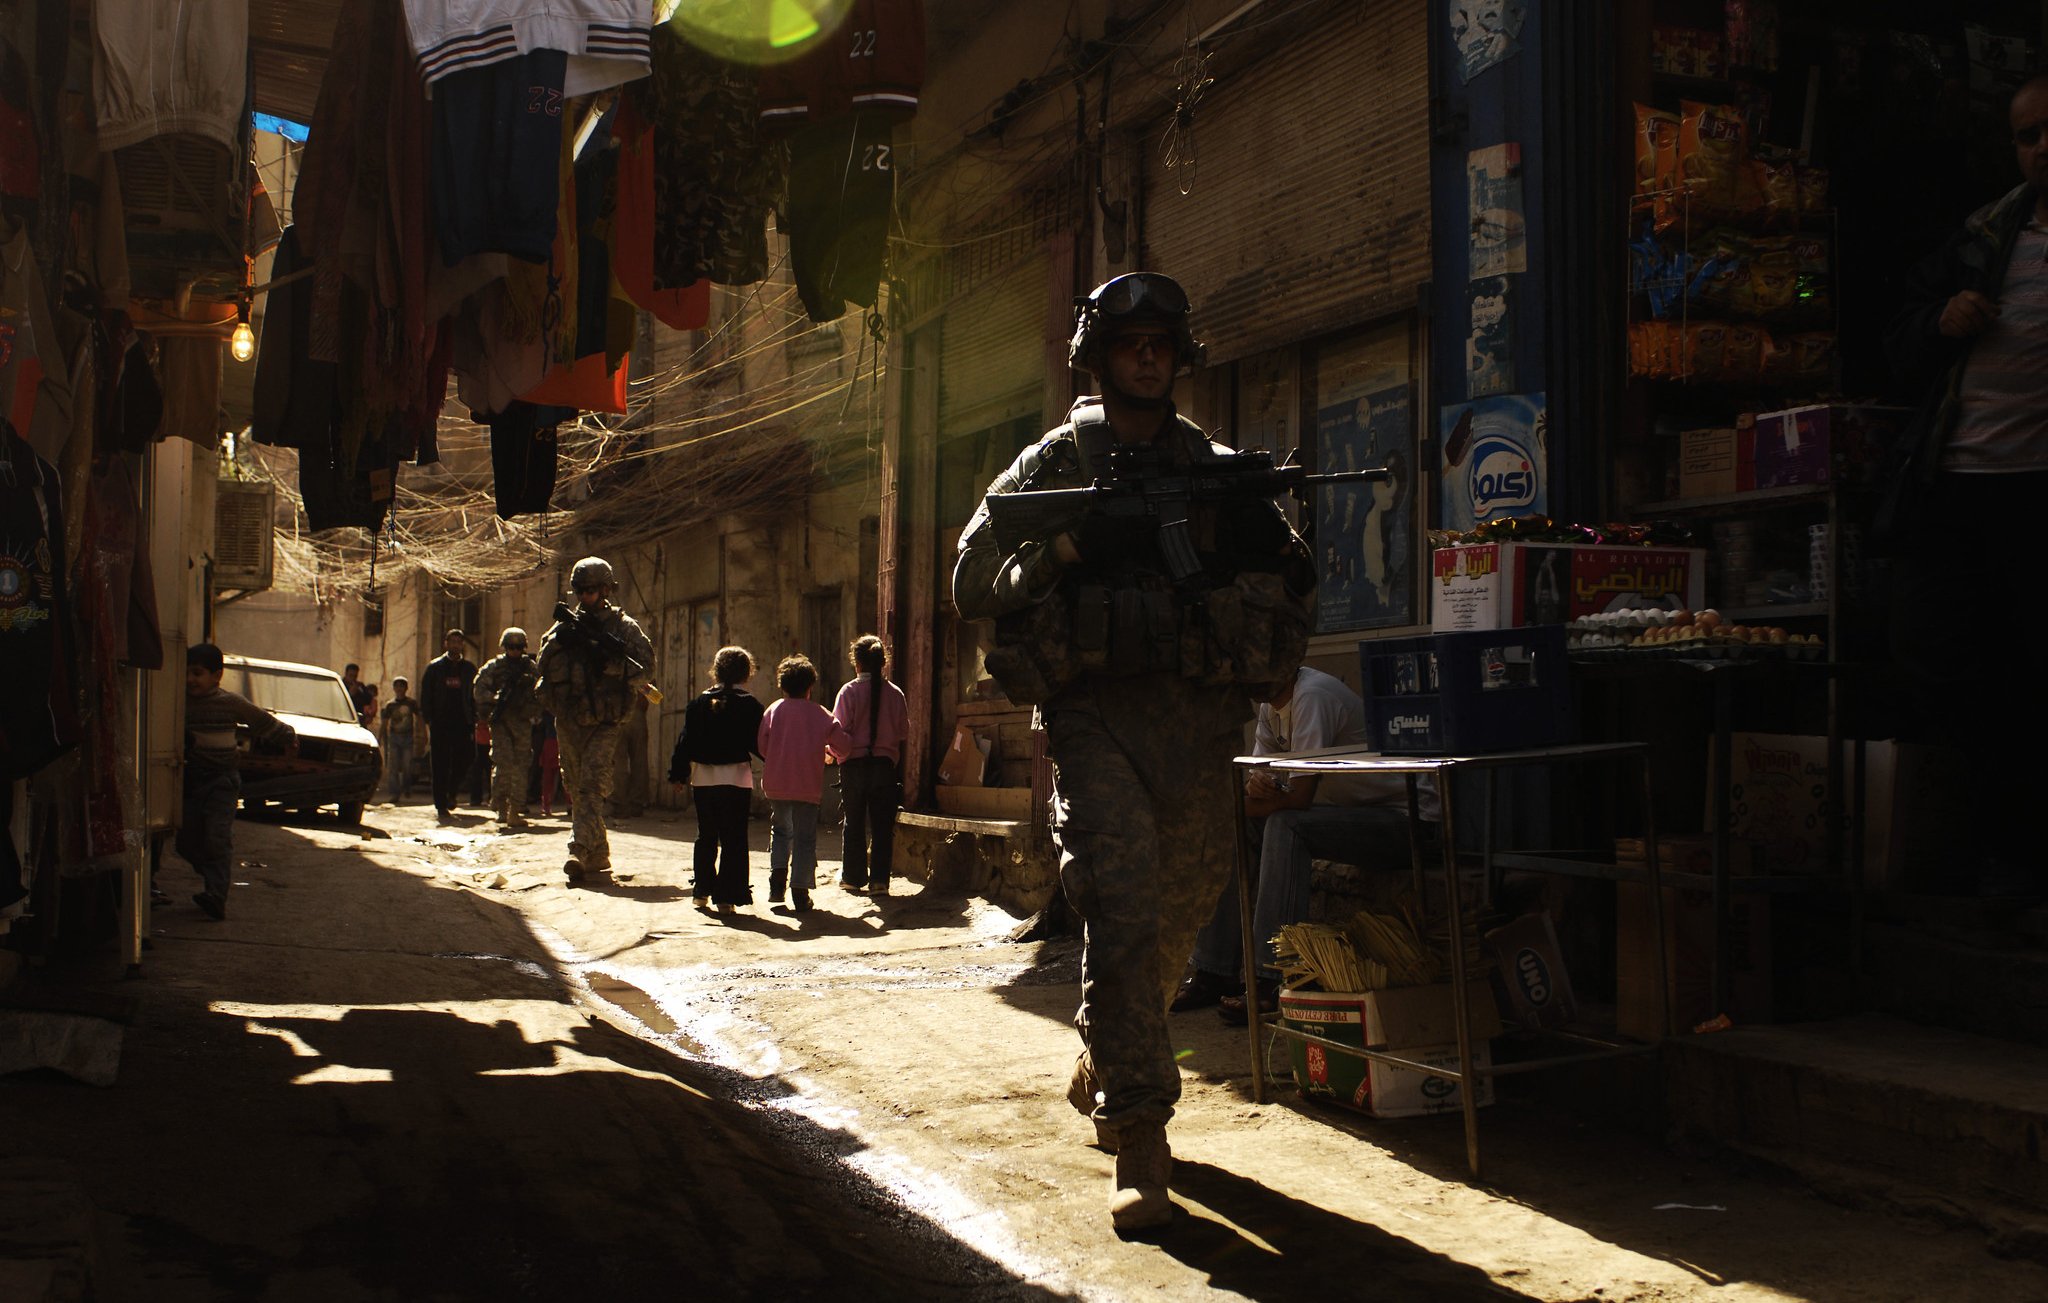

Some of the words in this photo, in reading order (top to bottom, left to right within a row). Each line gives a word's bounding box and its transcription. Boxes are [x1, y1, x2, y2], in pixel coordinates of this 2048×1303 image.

[849, 29, 876, 59] 22
[528, 85, 562, 117] 22
[862, 143, 890, 172] 22
[1576, 553, 1596, 563] AL
[1608, 554, 1686, 566] RIYADHI
[1576, 565, 1684, 604] الرياضي
[1519, 953, 1548, 1003] UNO
